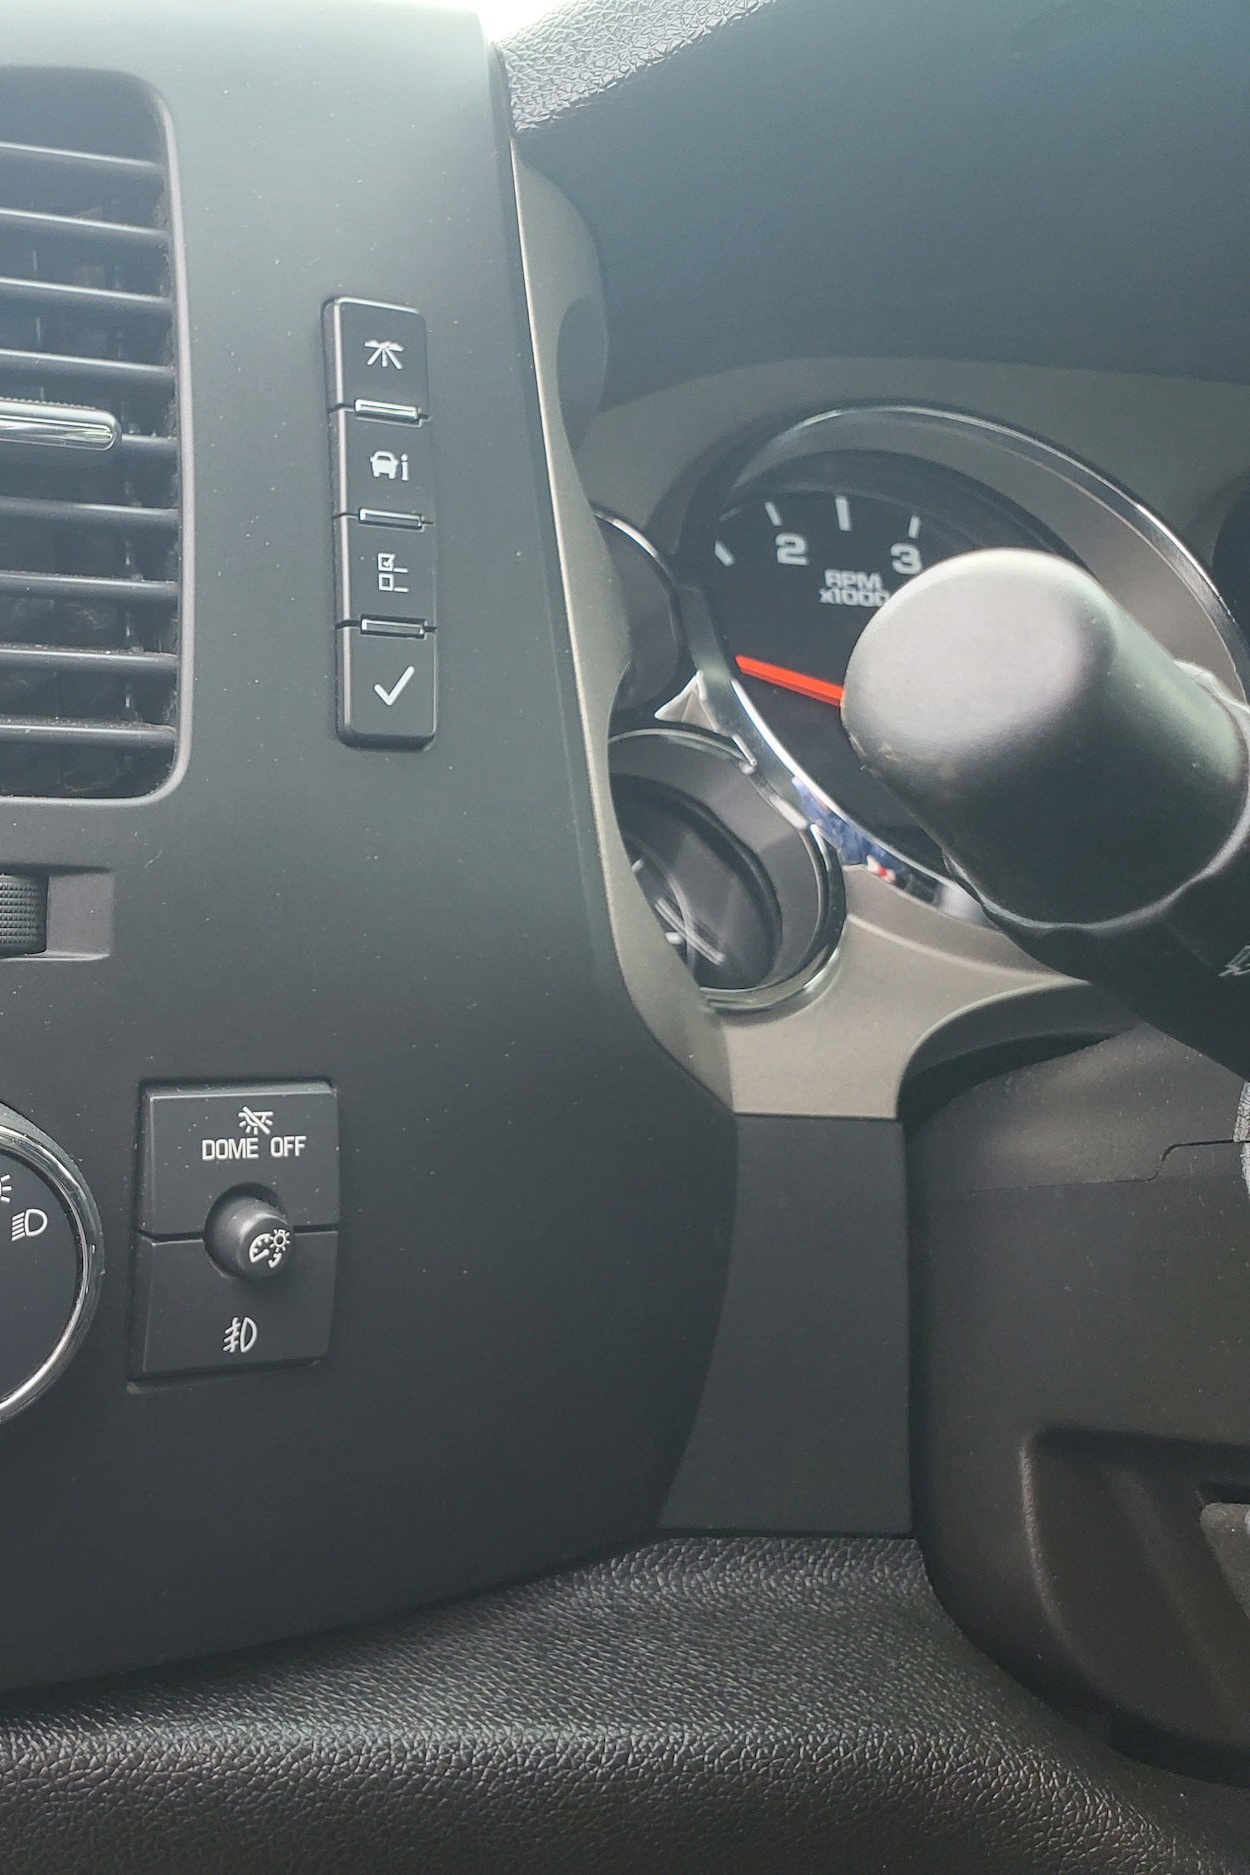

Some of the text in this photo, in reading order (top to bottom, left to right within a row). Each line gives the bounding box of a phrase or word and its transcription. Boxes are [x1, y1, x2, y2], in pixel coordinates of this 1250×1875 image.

[775, 532, 923, 575] 2 3
[824, 568, 883, 592] RPM
[201, 1135, 307, 1160] DOME OFF
